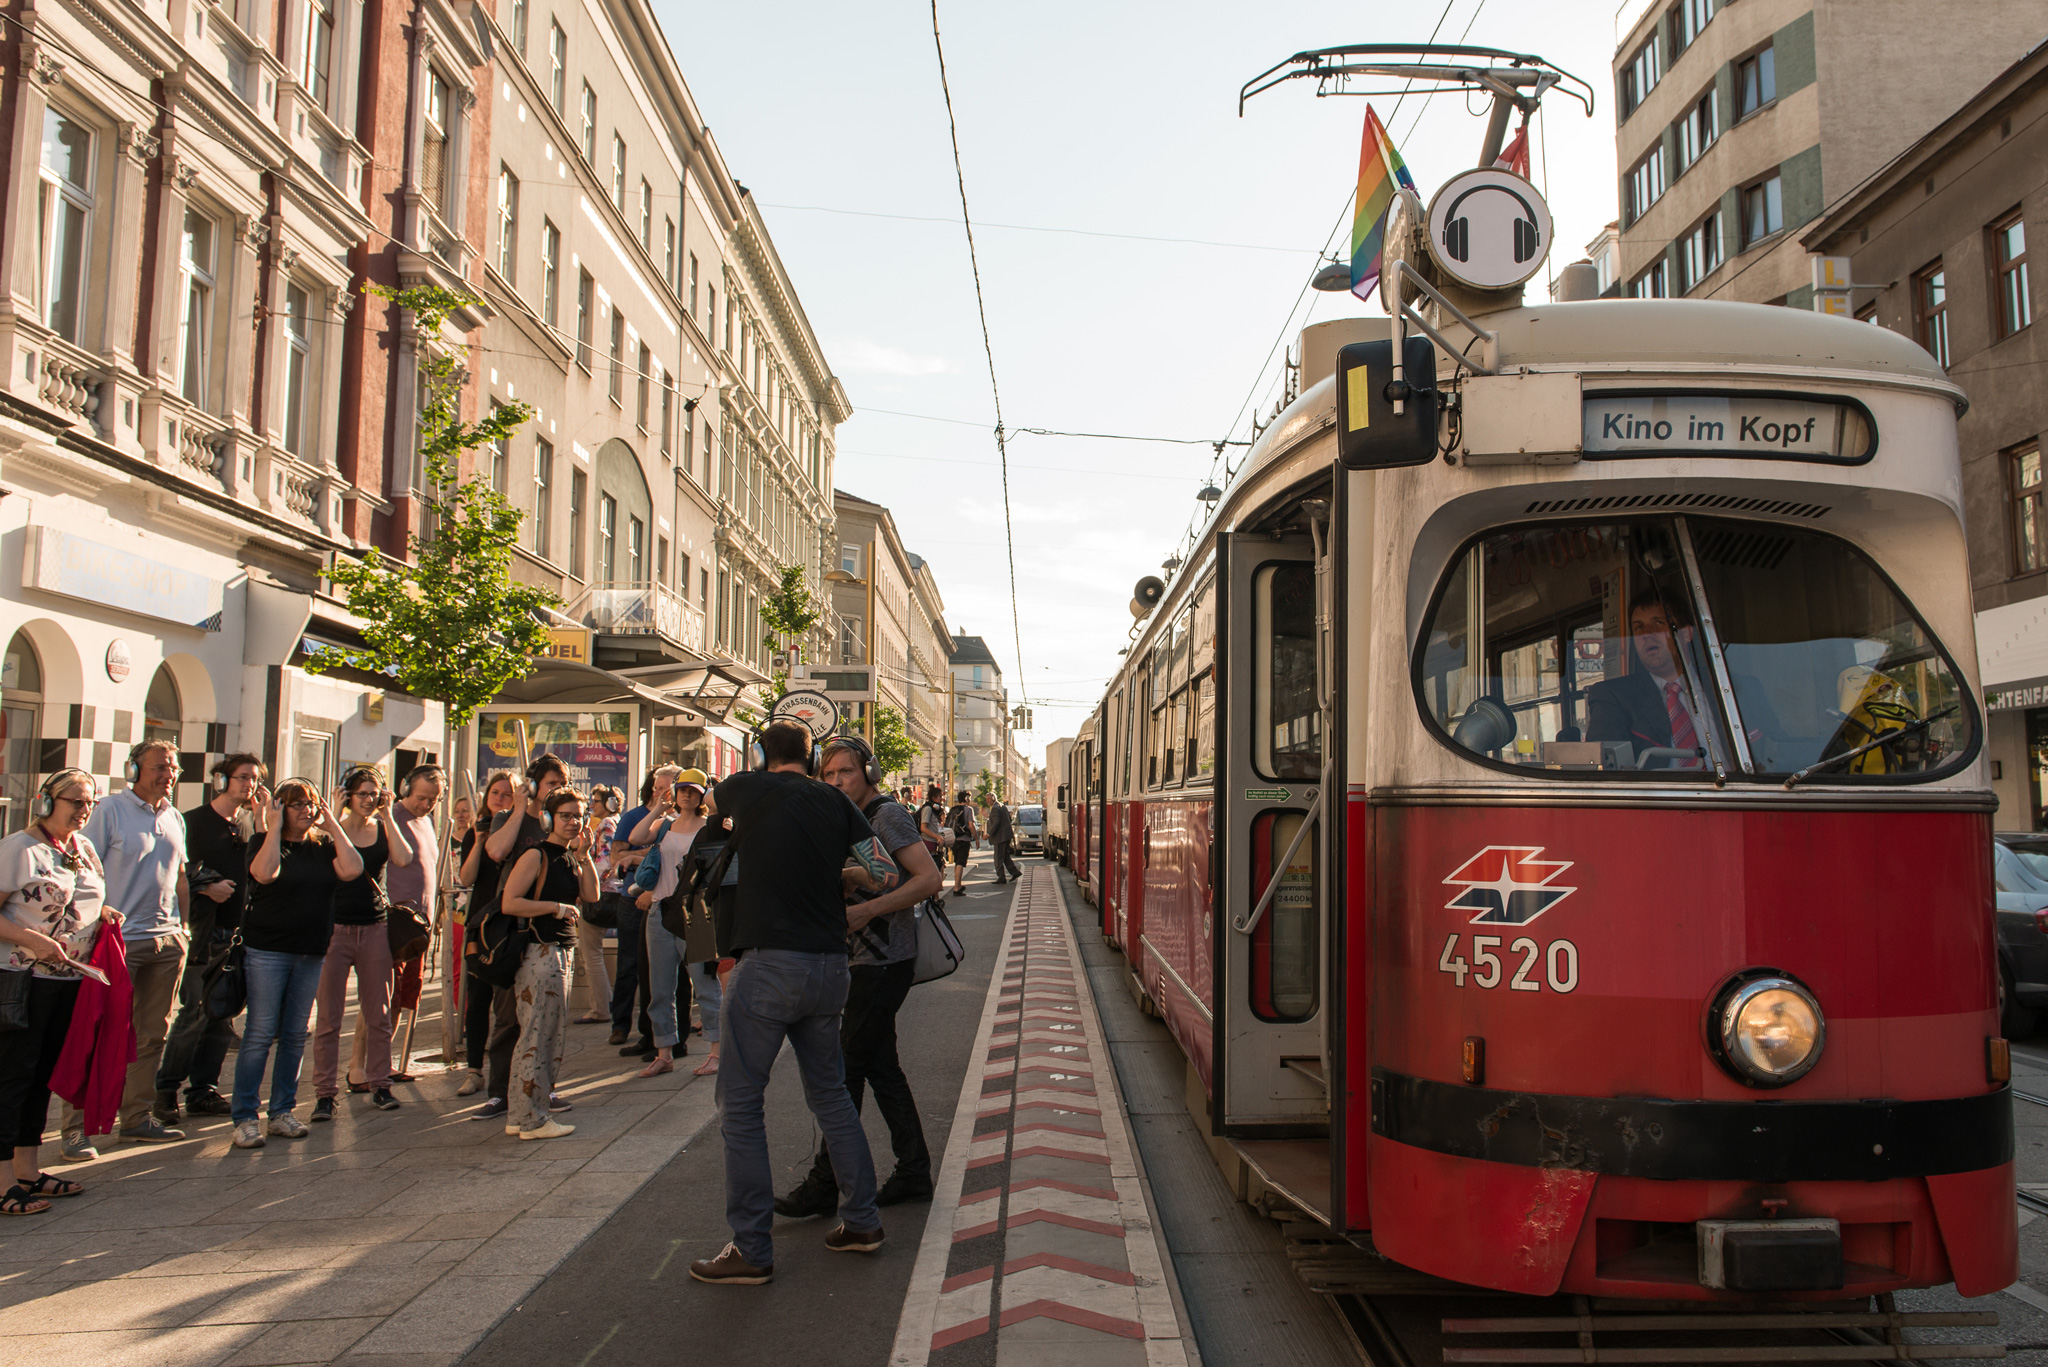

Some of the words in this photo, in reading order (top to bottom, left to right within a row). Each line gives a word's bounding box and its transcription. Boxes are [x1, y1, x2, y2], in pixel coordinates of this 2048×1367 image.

[1602, 413, 1673, 441] Kino
[1688, 414, 1724, 441] im
[1739, 415, 1816, 448] Kopf
[779, 697, 830, 716] STRASSENBAHN
[1439, 933, 1580, 994] 4520
